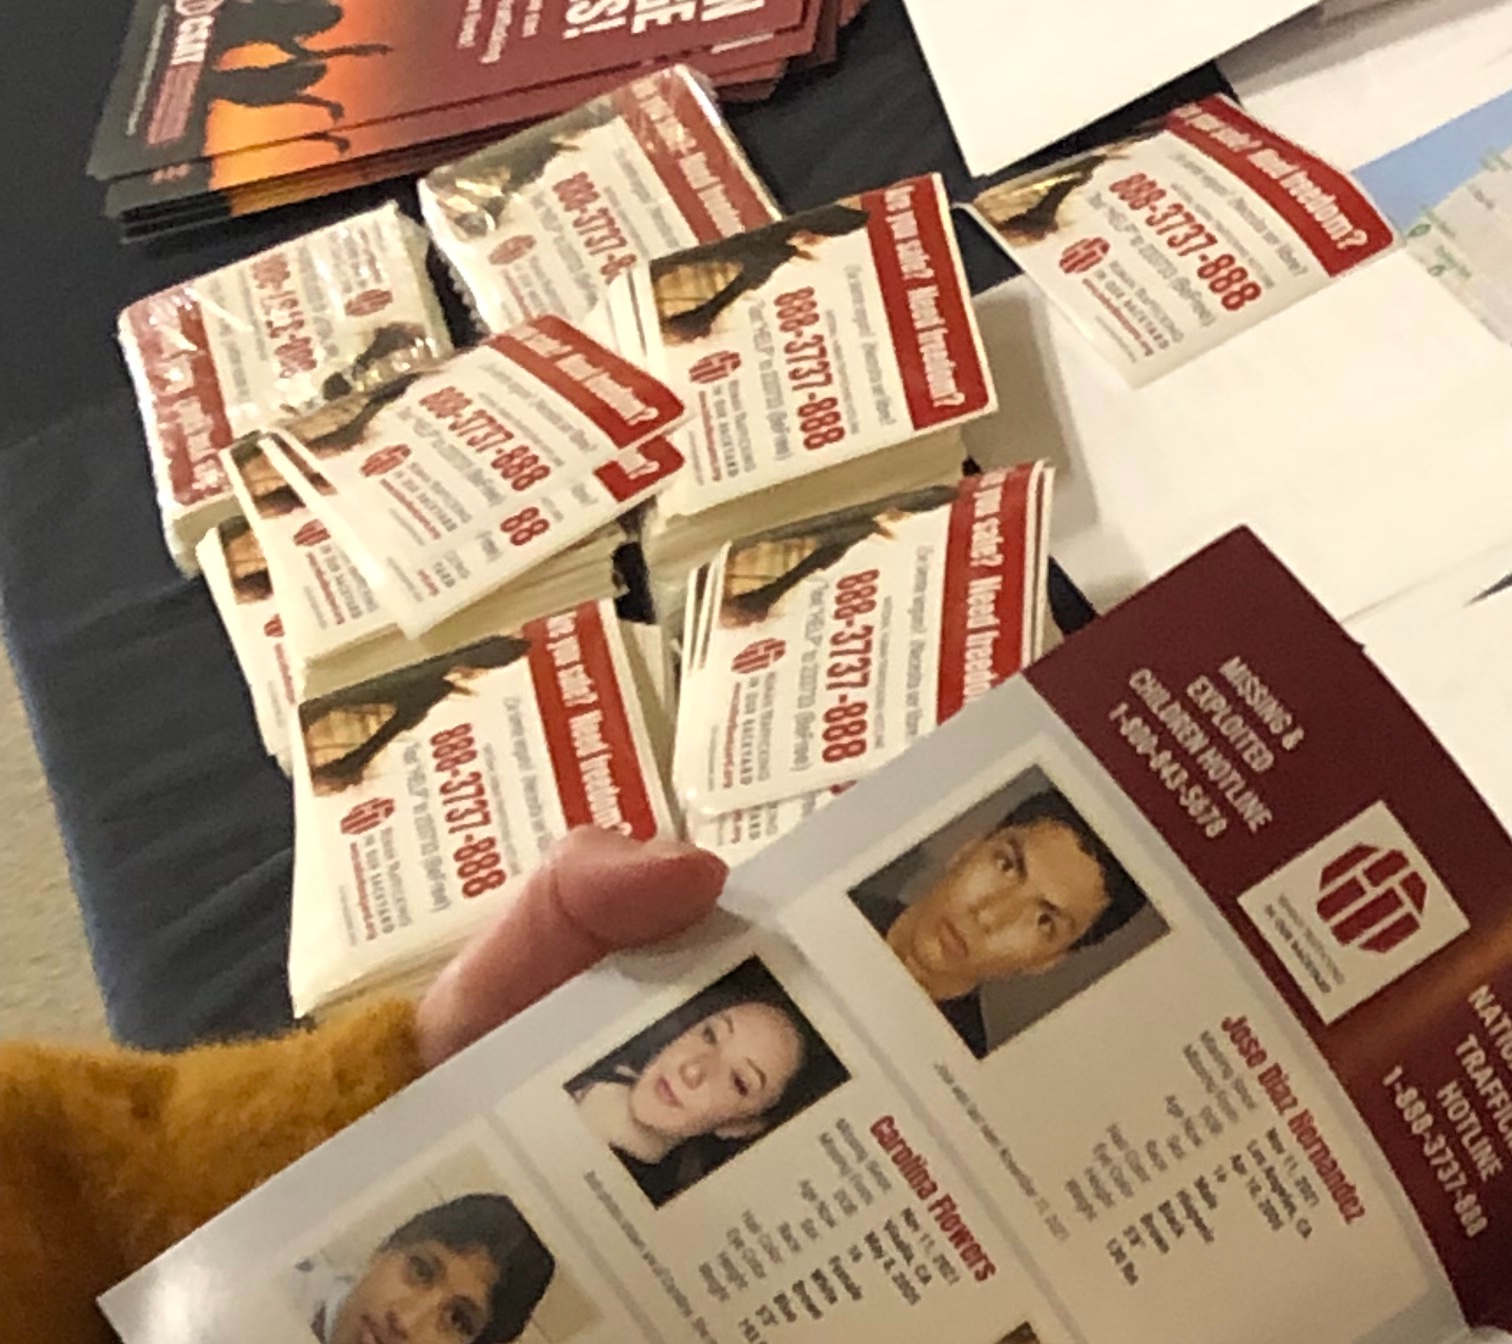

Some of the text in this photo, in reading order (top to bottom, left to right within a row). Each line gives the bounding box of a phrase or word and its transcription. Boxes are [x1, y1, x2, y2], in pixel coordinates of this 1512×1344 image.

[1107, 169, 1264, 314] 888-3737-888
[772, 286, 845, 451] 888-3737-888
[820, 568, 879, 765] 888-3737-888
[1126, 666, 1274, 834] CHILDREN HOTLINE
[1184, 674, 1276, 774] EXPLOITED
[1218, 656, 1307, 751] MISSING &
[427, 722, 508, 900] 888-3737-888
[868, 1113, 1001, 1284] Carolina Flowers
[1219, 1010, 1366, 1224] Jose Diaz Hernandez
[1380, 1064, 1490, 1237] 1-888-3737-888
[1434, 1080, 1503, 1182] HOTLINE
